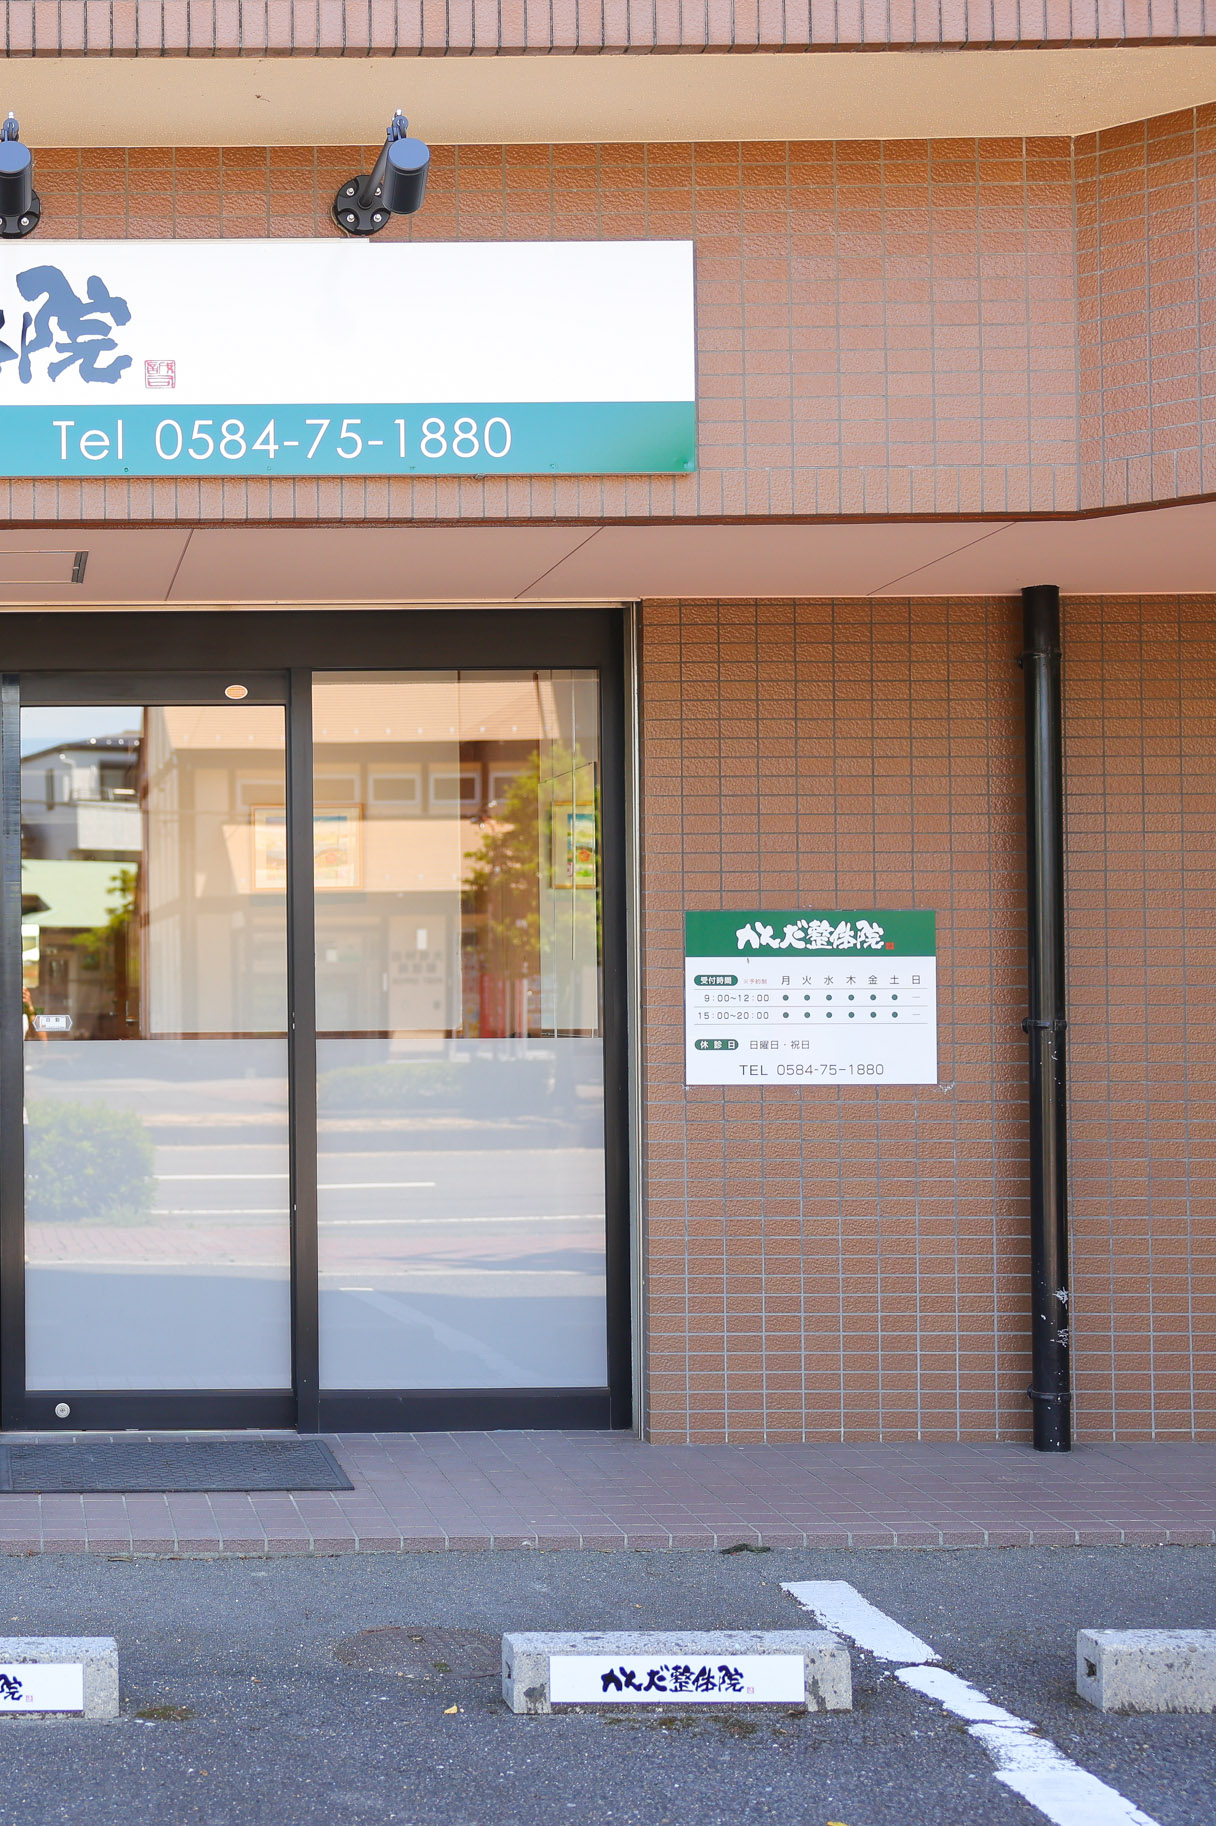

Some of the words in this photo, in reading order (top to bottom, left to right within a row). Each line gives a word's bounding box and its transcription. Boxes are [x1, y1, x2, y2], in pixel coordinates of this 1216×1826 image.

[53, 418, 124, 461] Tel
[155, 416, 512, 461] 0584-75-1880
[700, 976, 733, 985] 受付時間
[781, 975, 791, 985] 月
[802, 975, 812, 985] 火
[824, 975, 834, 985] 水
[846, 975, 856, 985] 木
[868, 975, 878, 985] 金
[889, 975, 900, 985] 土
[912, 975, 921, 985] 日
[739, 1064, 768, 1076] TEL
[776, 1063, 884, 1076] 0584-75-1880
